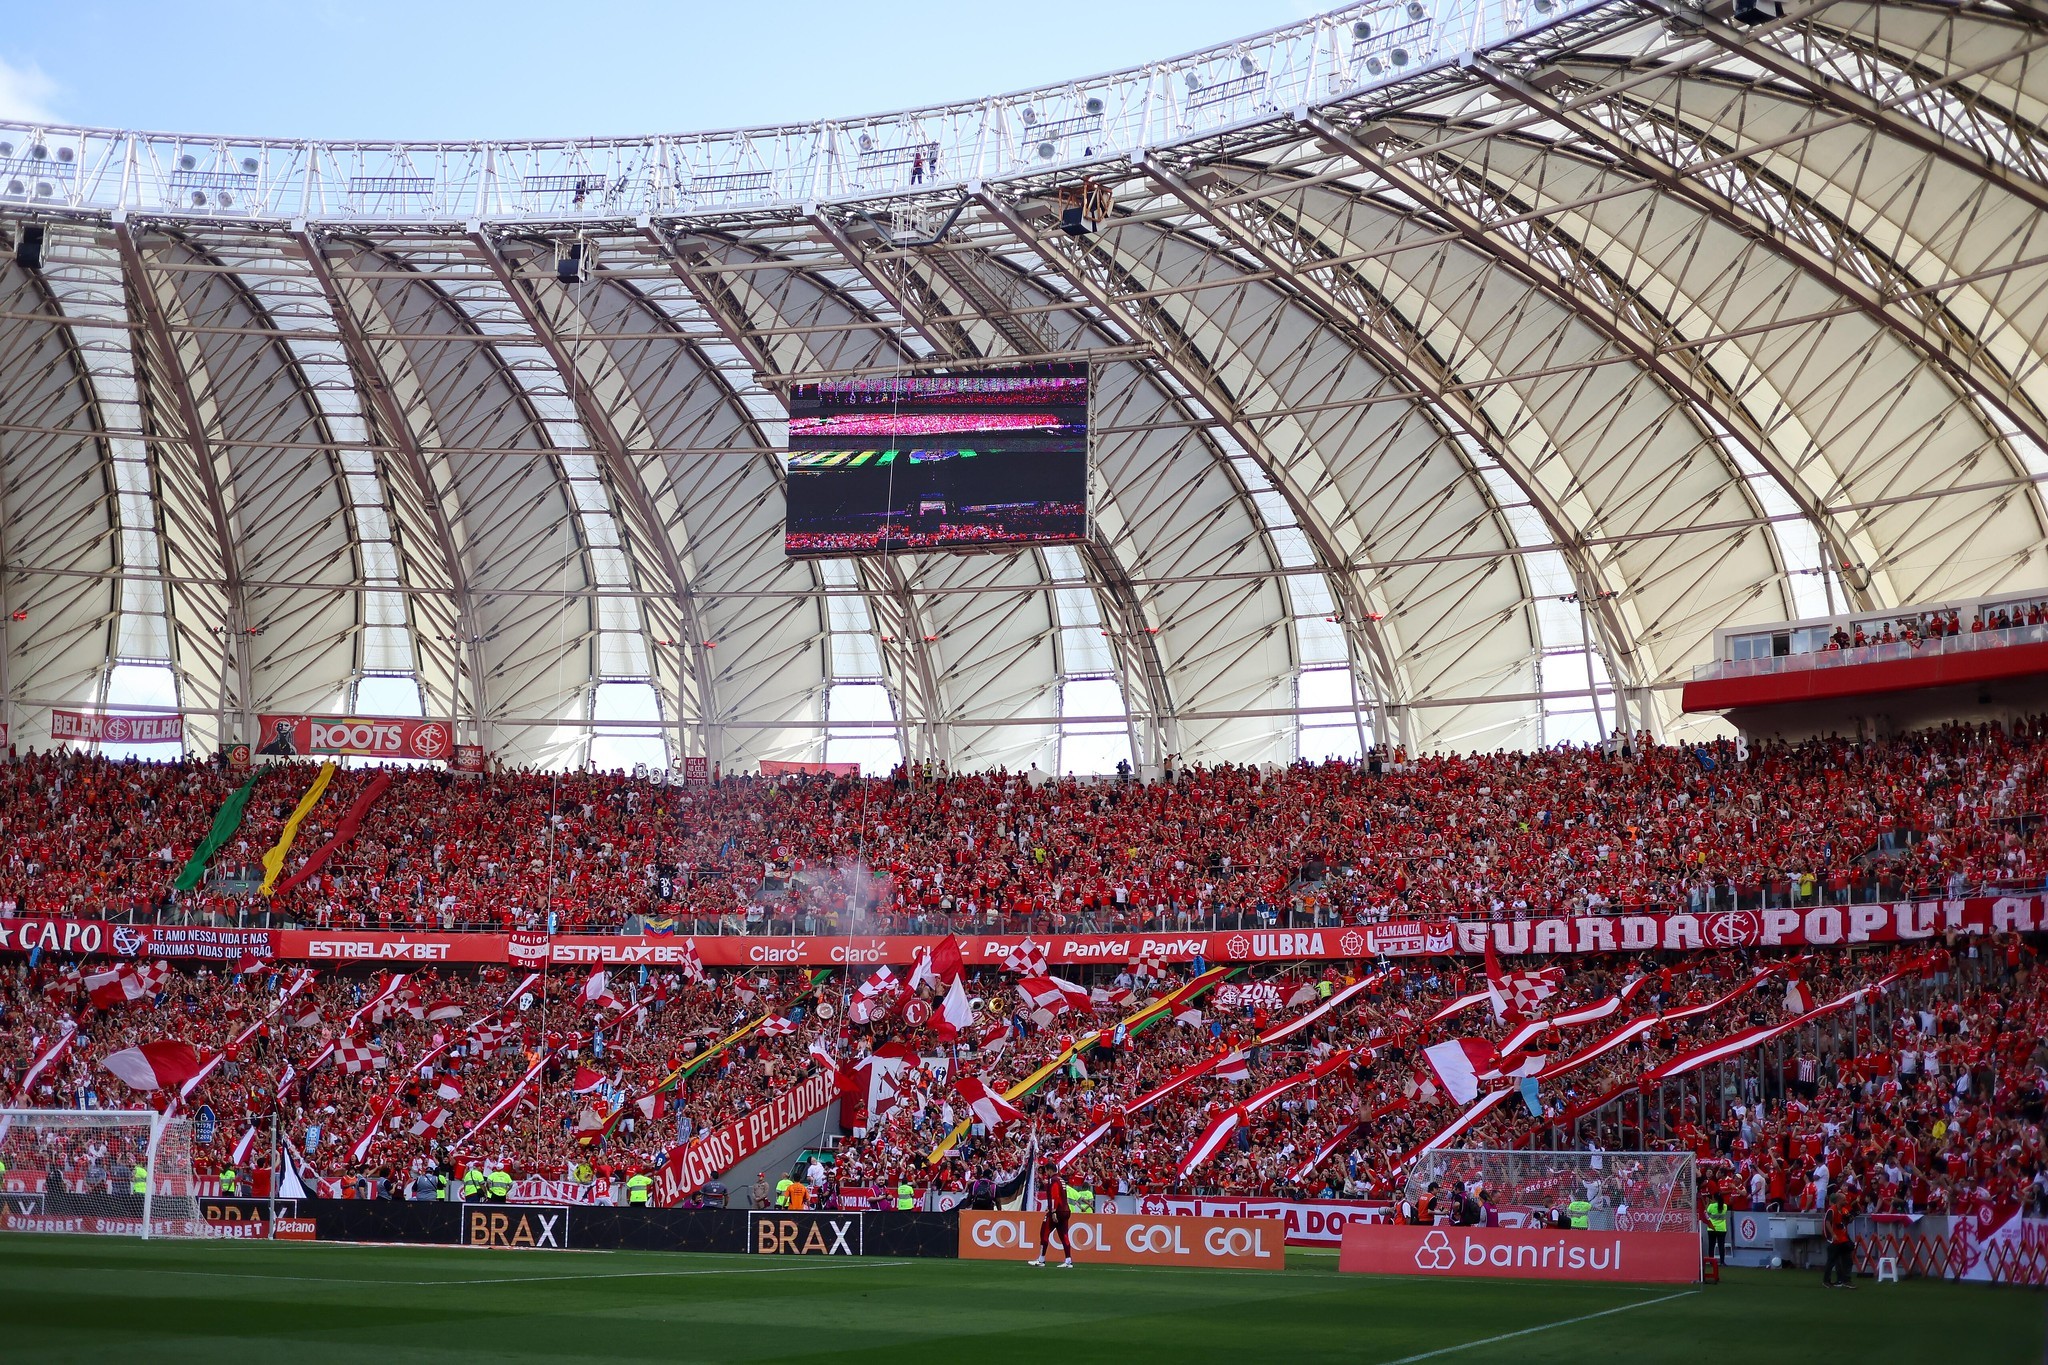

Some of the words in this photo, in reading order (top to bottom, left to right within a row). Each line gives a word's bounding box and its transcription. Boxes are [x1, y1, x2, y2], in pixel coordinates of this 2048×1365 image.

[130, 718, 182, 740] VELHO
[310, 724, 402, 750] ROOTS
[458, 757, 480, 765] ROOTS
[687, 778, 706, 787] INTER
[1376, 921, 1422, 938] CAMAQUÁ
[1457, 913, 1705, 955] GUARDA
[1760, 896, 2048, 945] POPULA
[19, 921, 102, 952] CAPO
[153, 929, 165, 941] TE
[166, 929, 187, 942] AMO
[187, 931, 218, 944] NESSA
[219, 932, 242, 945] VIDA
[242, 933, 249, 944] E
[249, 932, 268, 945] NAS
[1252, 933, 1325, 957] ULBRA
[1377, 939, 1421, 953] PTE
[148, 941, 195, 957] PRÓXIMAS
[196, 944, 225, 958] VIDAS
[226, 945, 242, 959] QUE
[523, 948, 536, 956] DO
[749, 944, 802, 962] Claro
[830, 944, 882, 962] Claro
[517, 959, 538, 968] SUL
[736, 1126, 748, 1157] E
[8, 1216, 83, 1232] SUPERBET
[185, 1221, 262, 1237] SUPERBET
[276, 1219, 315, 1234] Betano
[471, 1212, 559, 1248] BRAX
[758, 1219, 853, 1256] BRAX
[972, 1220, 1034, 1249] GOL
[1125, 1225, 1190, 1255] GOL
[1204, 1227, 1271, 1258] GOL
[1464, 1236, 1621, 1271] banrisul
